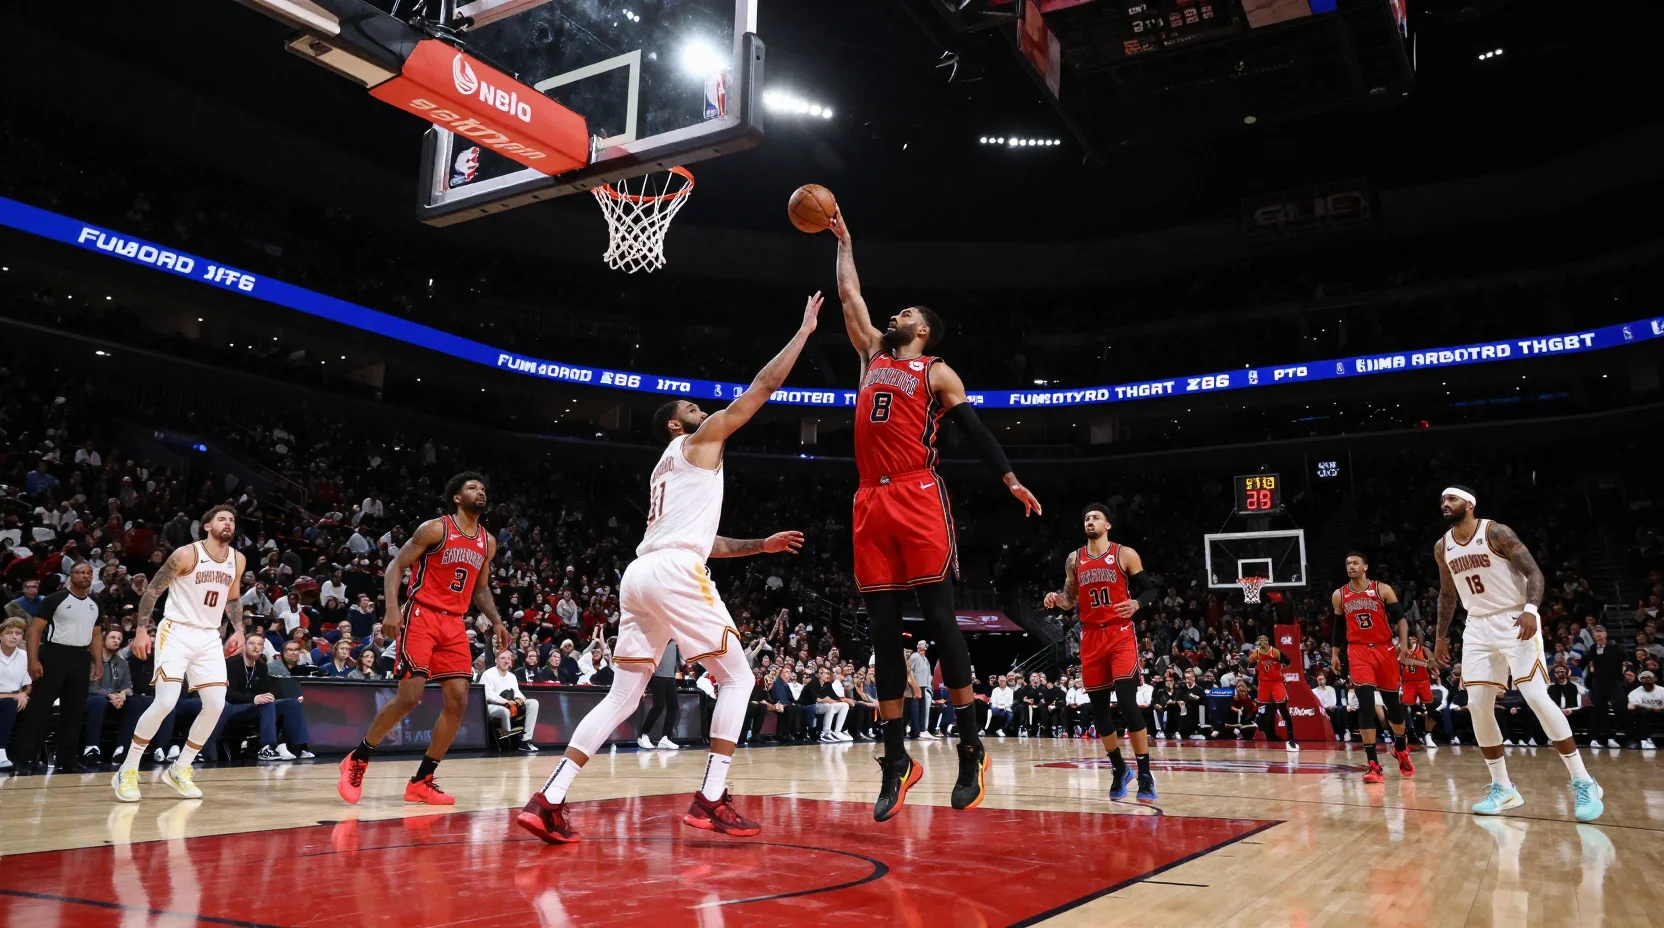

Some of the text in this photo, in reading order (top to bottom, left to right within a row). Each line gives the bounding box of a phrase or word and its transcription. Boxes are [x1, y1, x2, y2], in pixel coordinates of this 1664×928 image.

[870, 391, 893, 423] 8
[448, 566, 469, 593] 3
[1465, 574, 1485, 595] 18
[203, 590, 219, 608] 10
